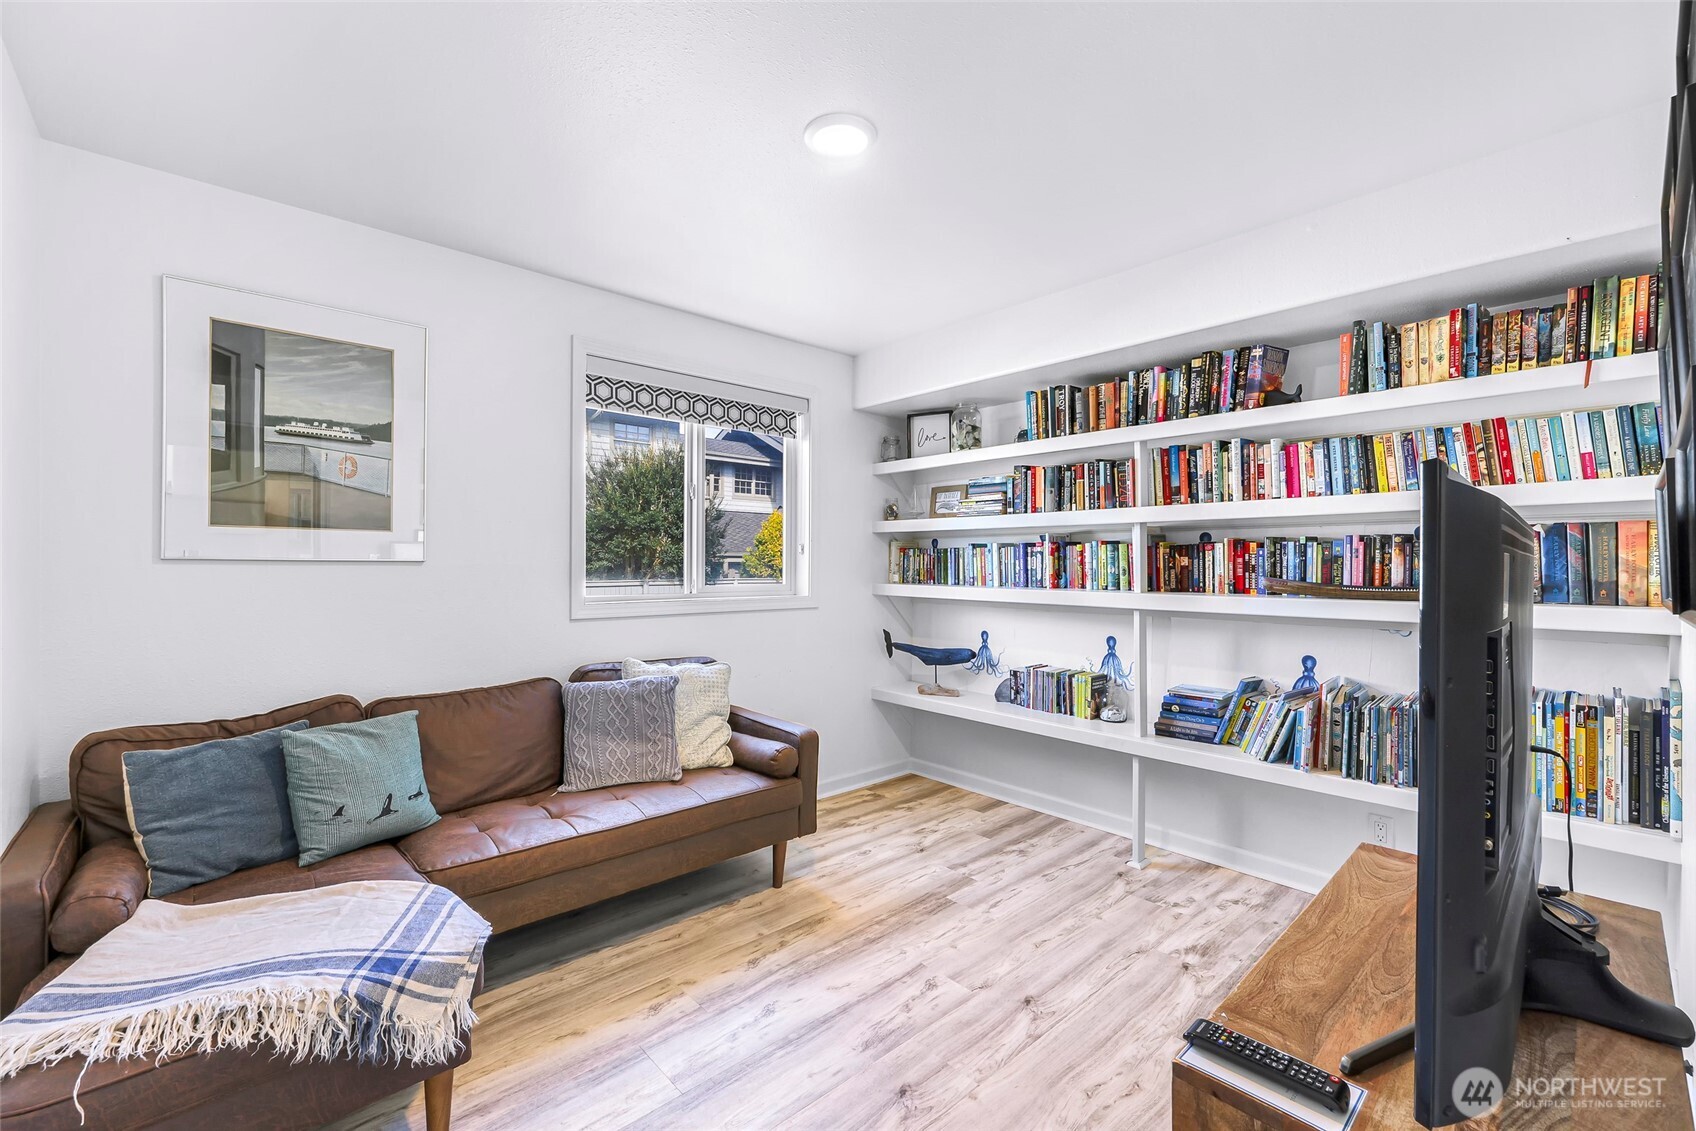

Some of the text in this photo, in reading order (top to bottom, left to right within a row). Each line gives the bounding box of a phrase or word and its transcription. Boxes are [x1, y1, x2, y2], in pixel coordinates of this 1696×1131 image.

[1567, 310, 1576, 344] KILL ORDER
[1600, 292, 1613, 342] INSURGENT
[1223, 357, 1231, 387] LEVIATHAN
[1641, 409, 1650, 424] Firefly
[1386, 444, 1394, 458] PARTY
